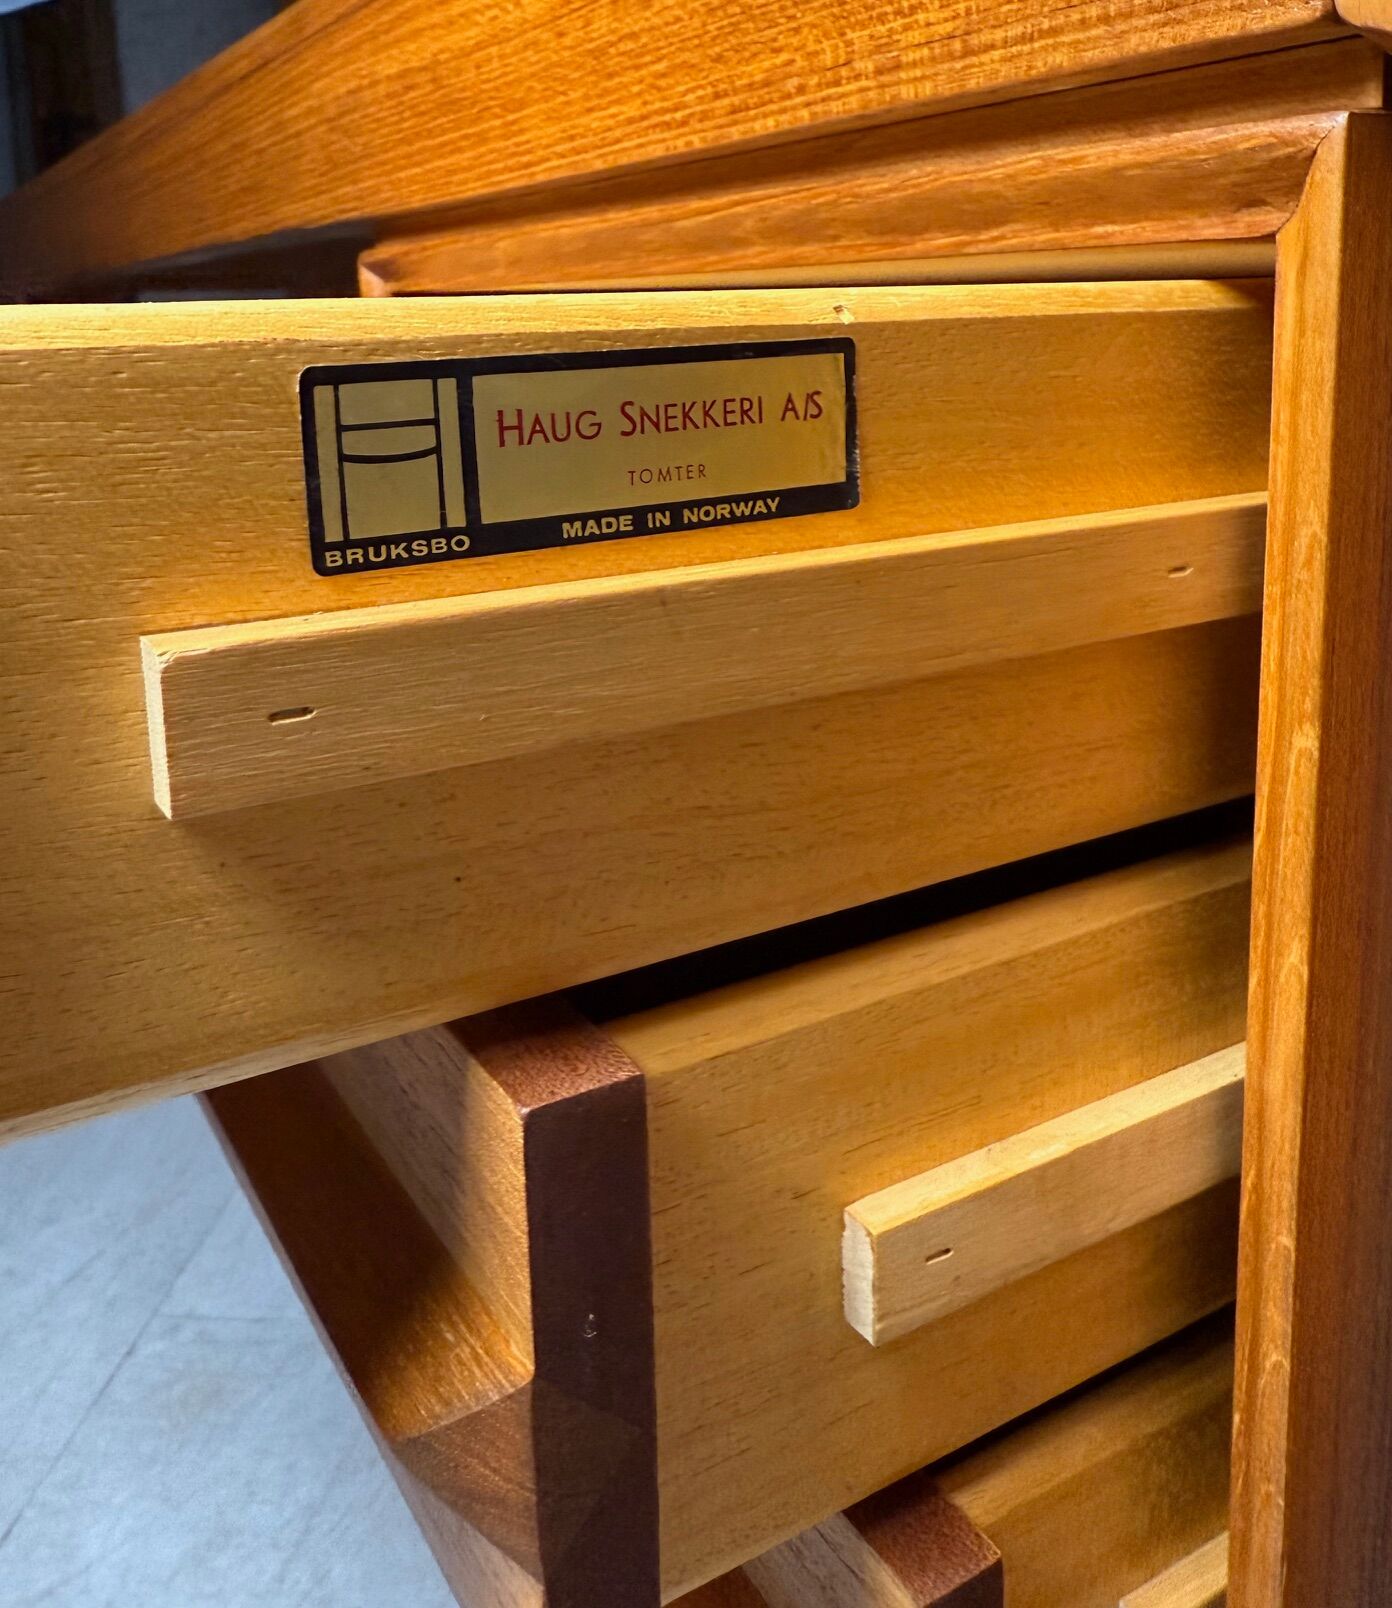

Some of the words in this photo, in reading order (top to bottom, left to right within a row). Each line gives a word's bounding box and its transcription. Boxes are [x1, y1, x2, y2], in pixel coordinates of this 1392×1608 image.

[496, 408, 602, 448] HAUG
[620, 395, 764, 437] SNEKKERI
[780, 390, 824, 421] A/S
[627, 464, 707, 486] TOMTER
[562, 513, 635, 539] MADE
[647, 510, 671, 529] IN
[683, 497, 781, 525] NORWAY
[325, 534, 470, 568] BRUKSBO
